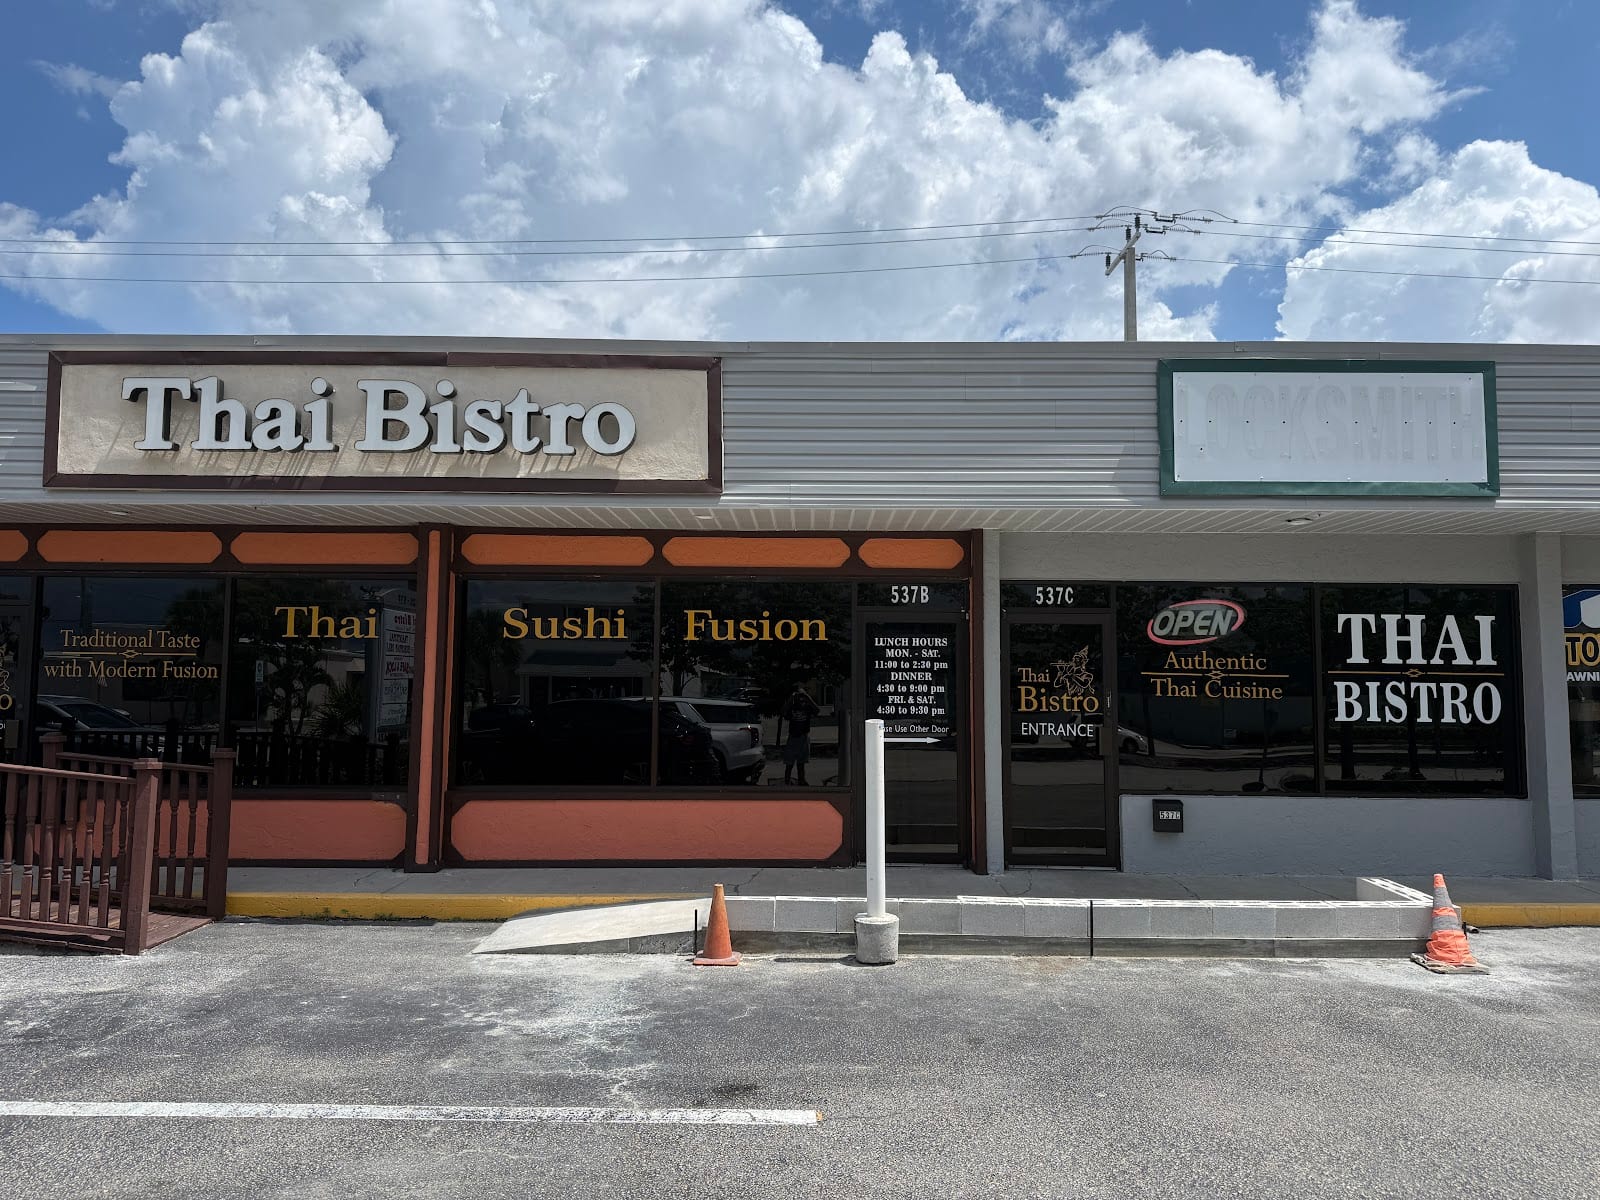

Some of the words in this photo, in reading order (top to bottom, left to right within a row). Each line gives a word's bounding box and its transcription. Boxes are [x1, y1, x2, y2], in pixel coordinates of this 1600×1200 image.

[121, 376, 340, 452] Thai
[354, 377, 637, 456] Bistro
[891, 585, 929, 604] 537B
[1035, 586, 1074, 604] 537C
[274, 606, 379, 639] Thai
[503, 607, 628, 640] Sushi
[684, 609, 828, 641] Fusion
[1153, 610, 1233, 636] OPEN
[60, 628, 152, 650] Traditional
[156, 629, 200, 650] Taste
[874, 637, 909, 647] LUNCH
[912, 637, 948, 647] HOURS
[1337, 613, 1498, 666] THAI
[885, 649, 913, 658] MON.
[921, 649, 941, 658] SAT.
[1565, 633, 1600, 667] TO
[44, 661, 82, 679] with
[88, 662, 156, 680] Modern
[163, 663, 219, 680] Fusion
[875, 660, 898, 669] 11:00
[900, 660, 910, 669] to
[912, 660, 931, 669] 2:30
[933, 662, 949, 670] pm
[1164, 651, 1267, 671] Authentic
[890, 671, 932, 681] DINNER
[1018, 667, 1050, 683] Thai
[876, 684, 895, 693] 4:30
[897, 684, 907, 692] to
[909, 684, 928, 693] 9:00
[930, 685, 945, 694] pm
[1151, 677, 1197, 697] Thai
[1204, 679, 1283, 699] Cuisine
[888, 696, 906, 704] FRI.
[907, 696, 915, 704] &
[916, 696, 936, 704] SAT.
[1017, 685, 1099, 712] Bistro
[1334, 681, 1502, 724] BISTRO
[876, 705, 895, 714] 4:30
[898, 706, 908, 714] to
[910, 706, 929, 714] 9:30
[931, 707, 945, 716] pm
[895, 725, 907, 733] Use
[909, 725, 930, 733] Other
[931, 725, 949, 733] Door
[1021, 722, 1094, 737] ENTRANCE
